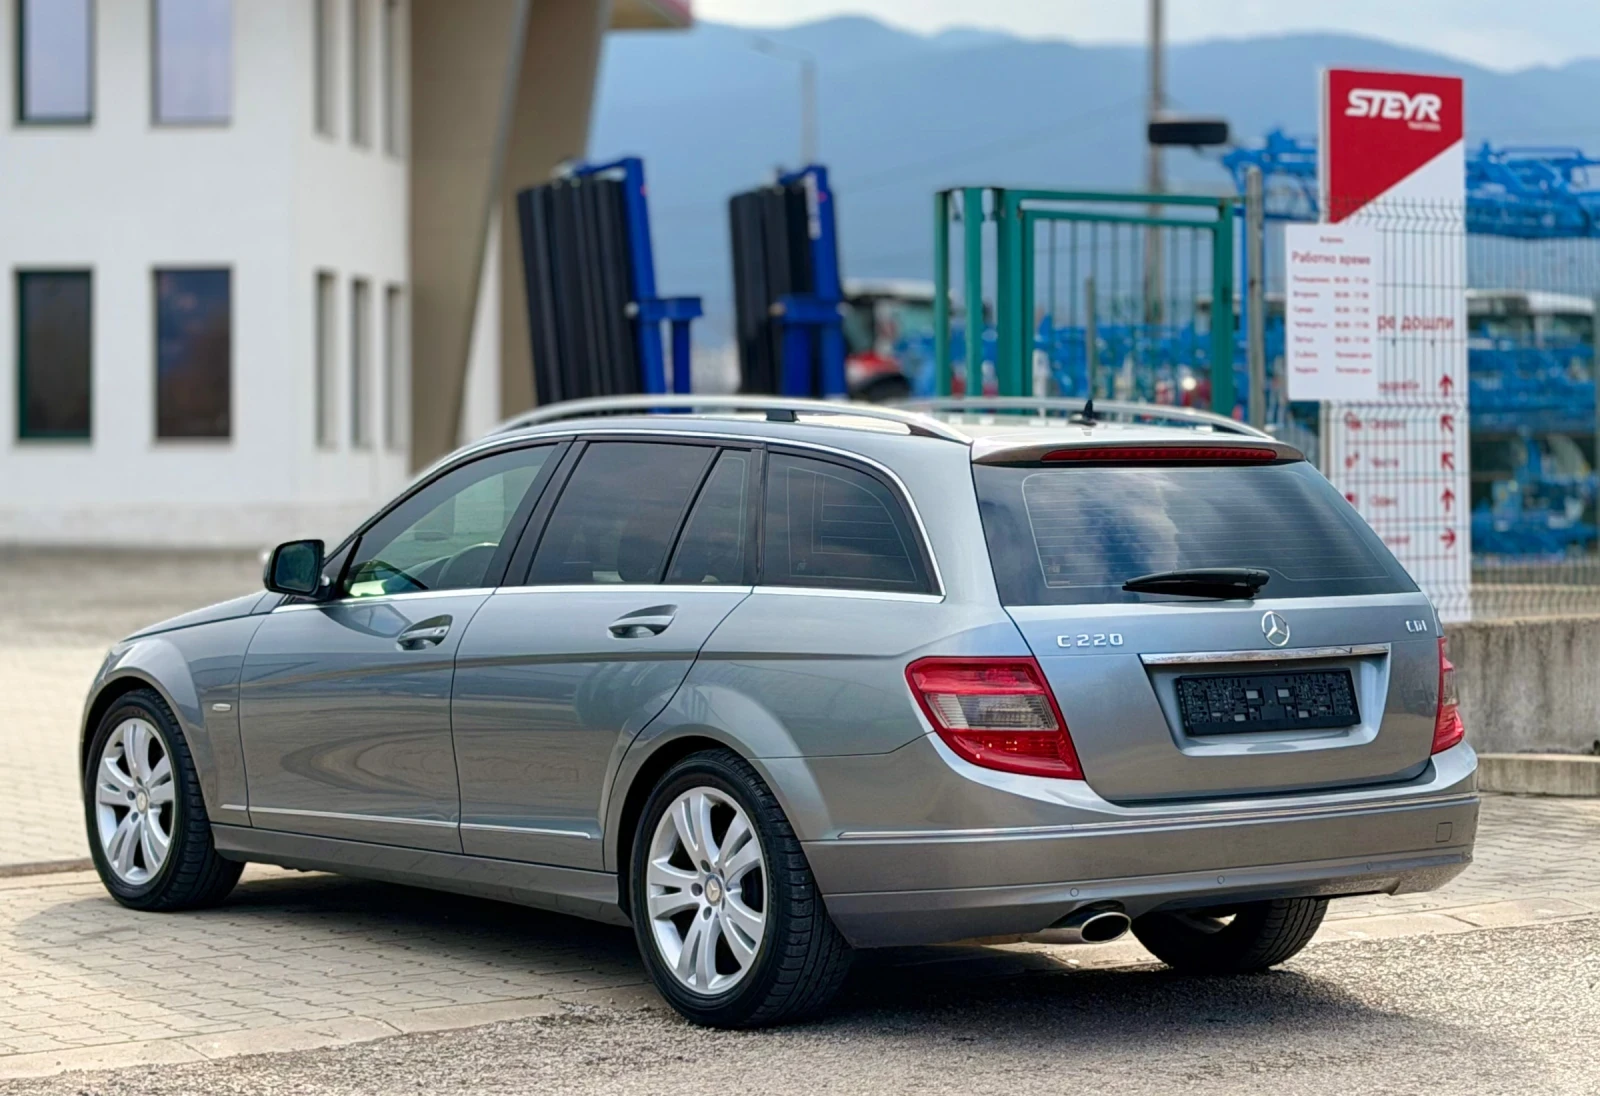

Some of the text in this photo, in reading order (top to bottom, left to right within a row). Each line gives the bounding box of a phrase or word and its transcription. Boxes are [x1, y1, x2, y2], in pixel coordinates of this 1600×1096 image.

[1344, 87, 1442, 122] STEYR
[1292, 250, 1370, 267] Работно време
[1401, 315, 1455, 333] дошли
[1405, 619, 1428, 633] CDI
[1057, 633, 1124, 648] C 220
